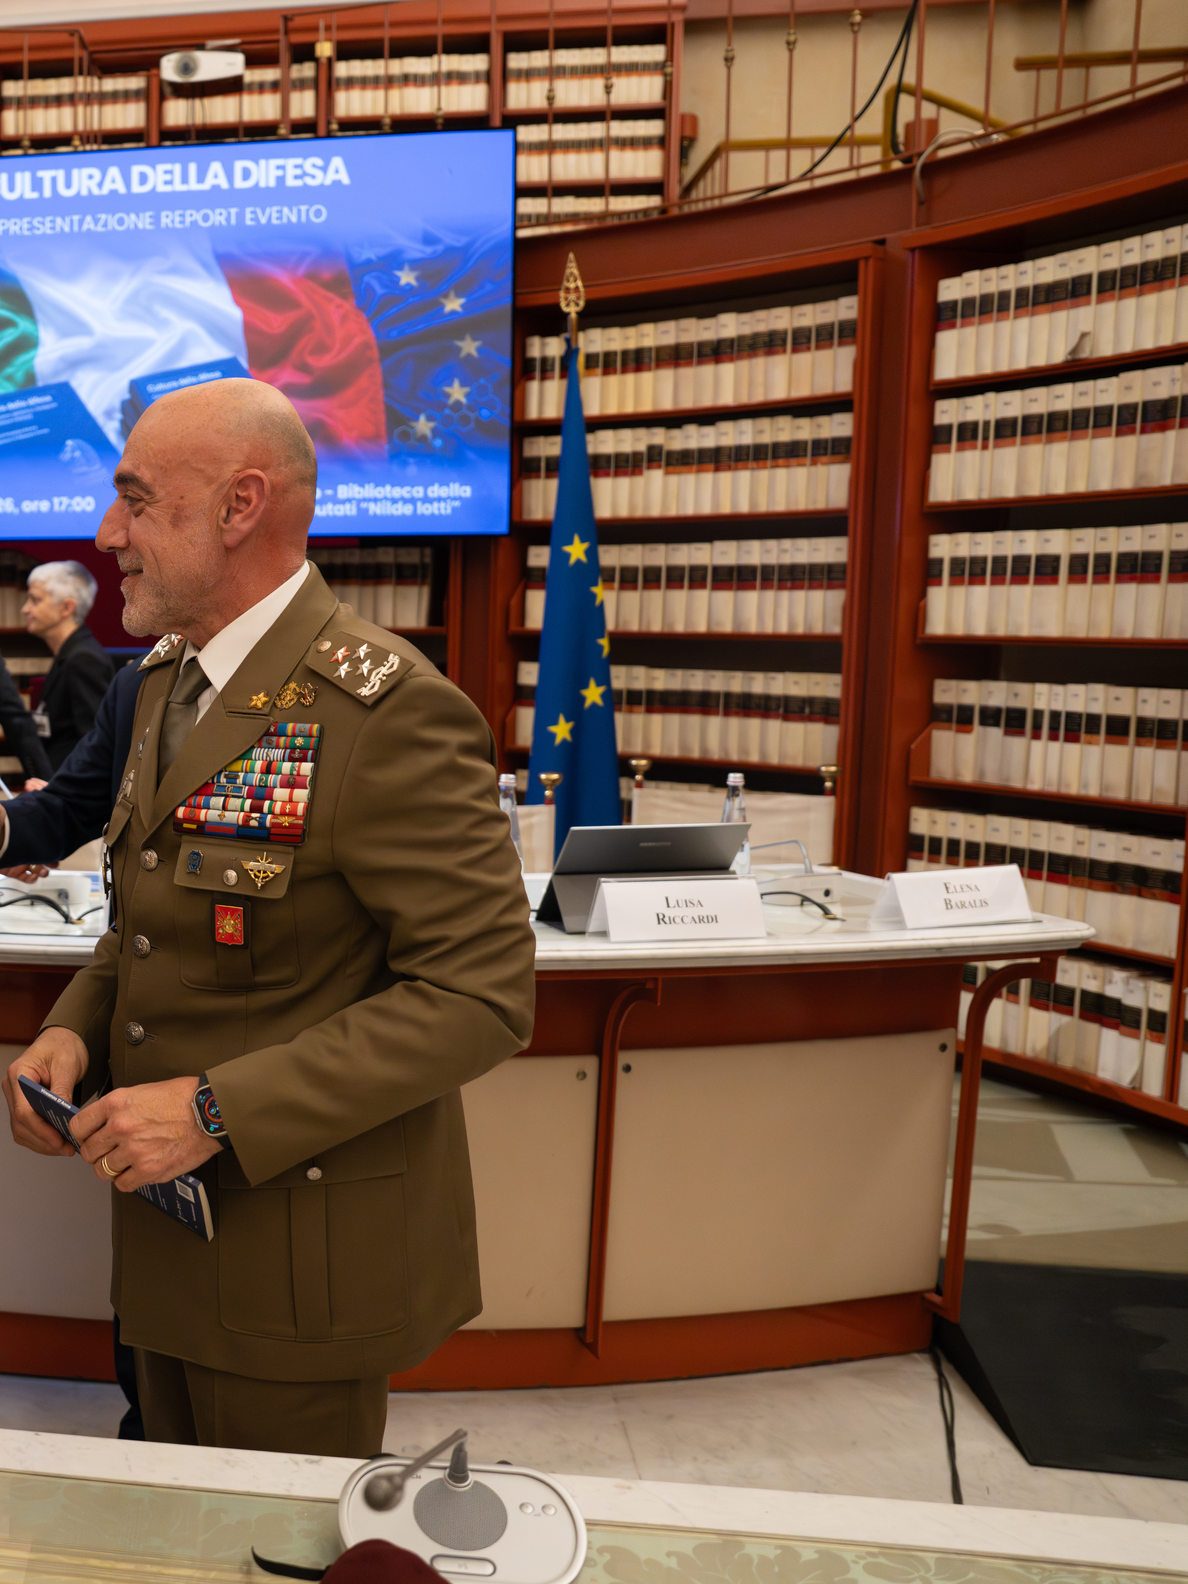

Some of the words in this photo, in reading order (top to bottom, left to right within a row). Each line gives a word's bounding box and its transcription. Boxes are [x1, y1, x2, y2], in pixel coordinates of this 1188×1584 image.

[130, 161, 230, 194] DELLA
[233, 156, 351, 190] DIFESA
[160, 207, 240, 230] REPORT
[245, 203, 328, 226] EVENTO
[336, 482, 425, 500] Biblioteca
[426, 482, 472, 499] della
[20, 499, 52, 514] ore
[52, 495, 96, 514] 17:00
[315, 500, 358, 517] utati
[943, 881, 981, 894] ELENA
[664, 895, 704, 909] LUISA
[943, 897, 990, 911] BARALIS
[655, 911, 719, 925] RICCARDI
